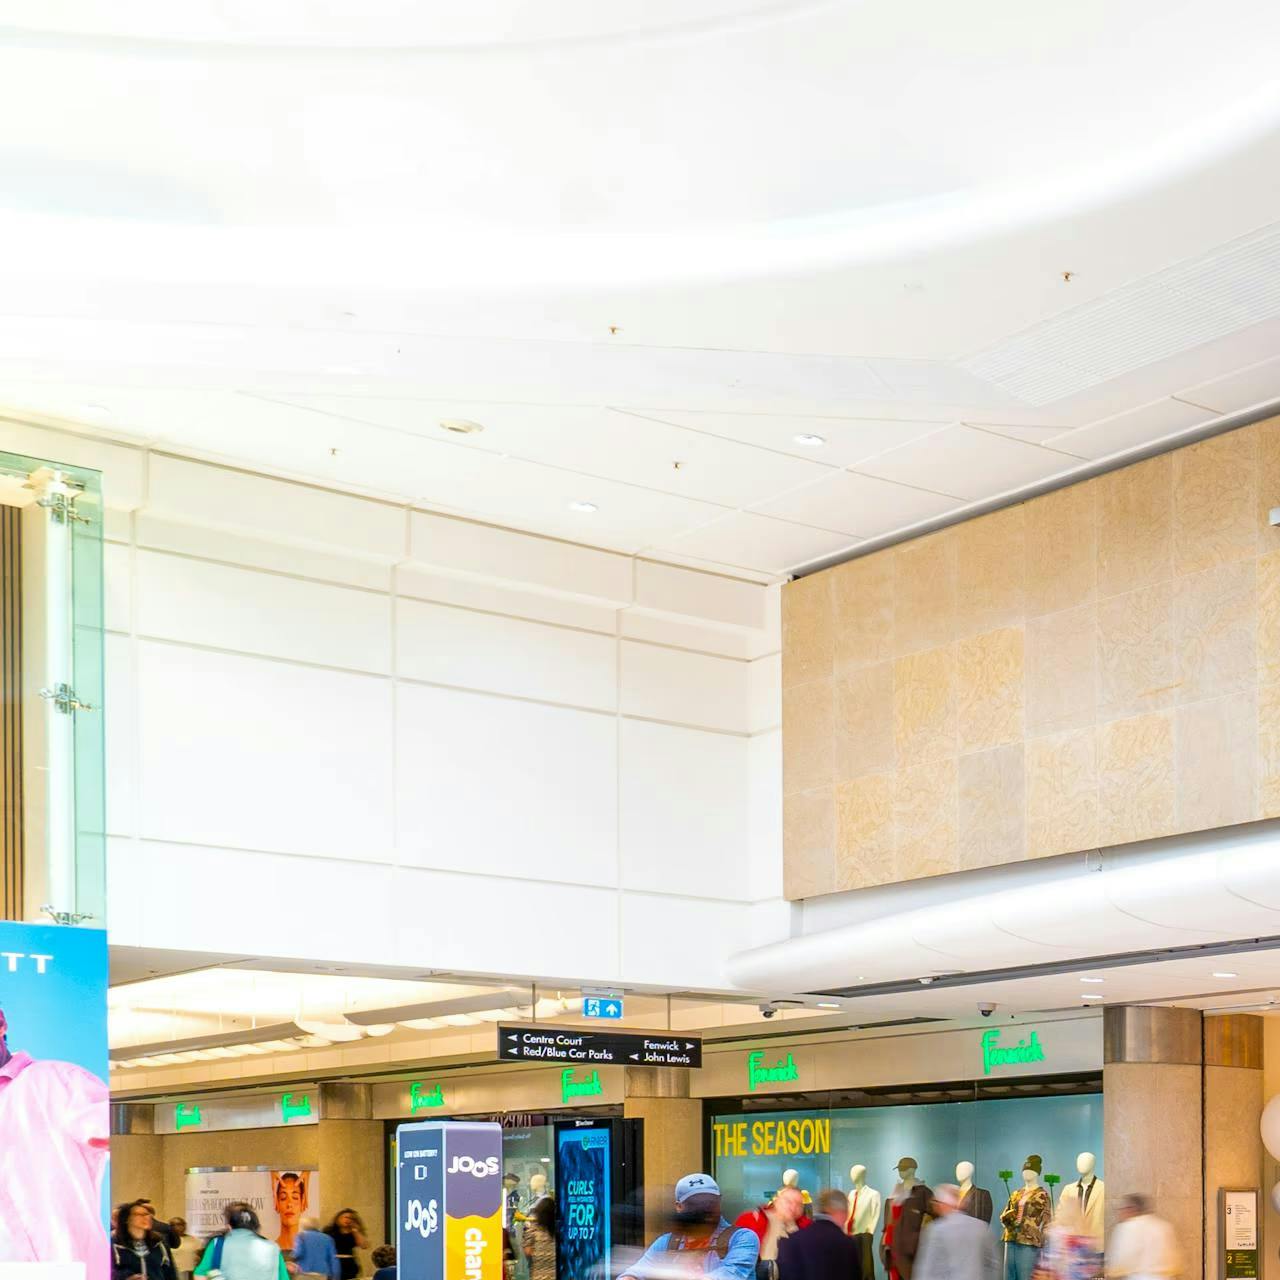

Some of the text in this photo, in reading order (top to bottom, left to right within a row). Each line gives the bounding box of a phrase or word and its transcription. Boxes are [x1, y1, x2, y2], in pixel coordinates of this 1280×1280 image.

[522, 1034, 583, 1046] Centre Court
[644, 1040, 679, 1051] Fenwick
[523, 1046, 613, 1060] Red/Blue Car Parks
[643, 1053, 690, 1064] John Lewis
[981, 1030, 1045, 1075] Fenwick
[748, 1051, 799, 1091] Fenwick
[713, 1118, 831, 1157] THE SEASON
[448, 1156, 499, 1178] JOOS
[568, 1180, 594, 1195] CURLS
[405, 1199, 438, 1238] JOOS
[568, 1204, 594, 1226] FOR
[568, 1228, 595, 1239] UP TO 7
